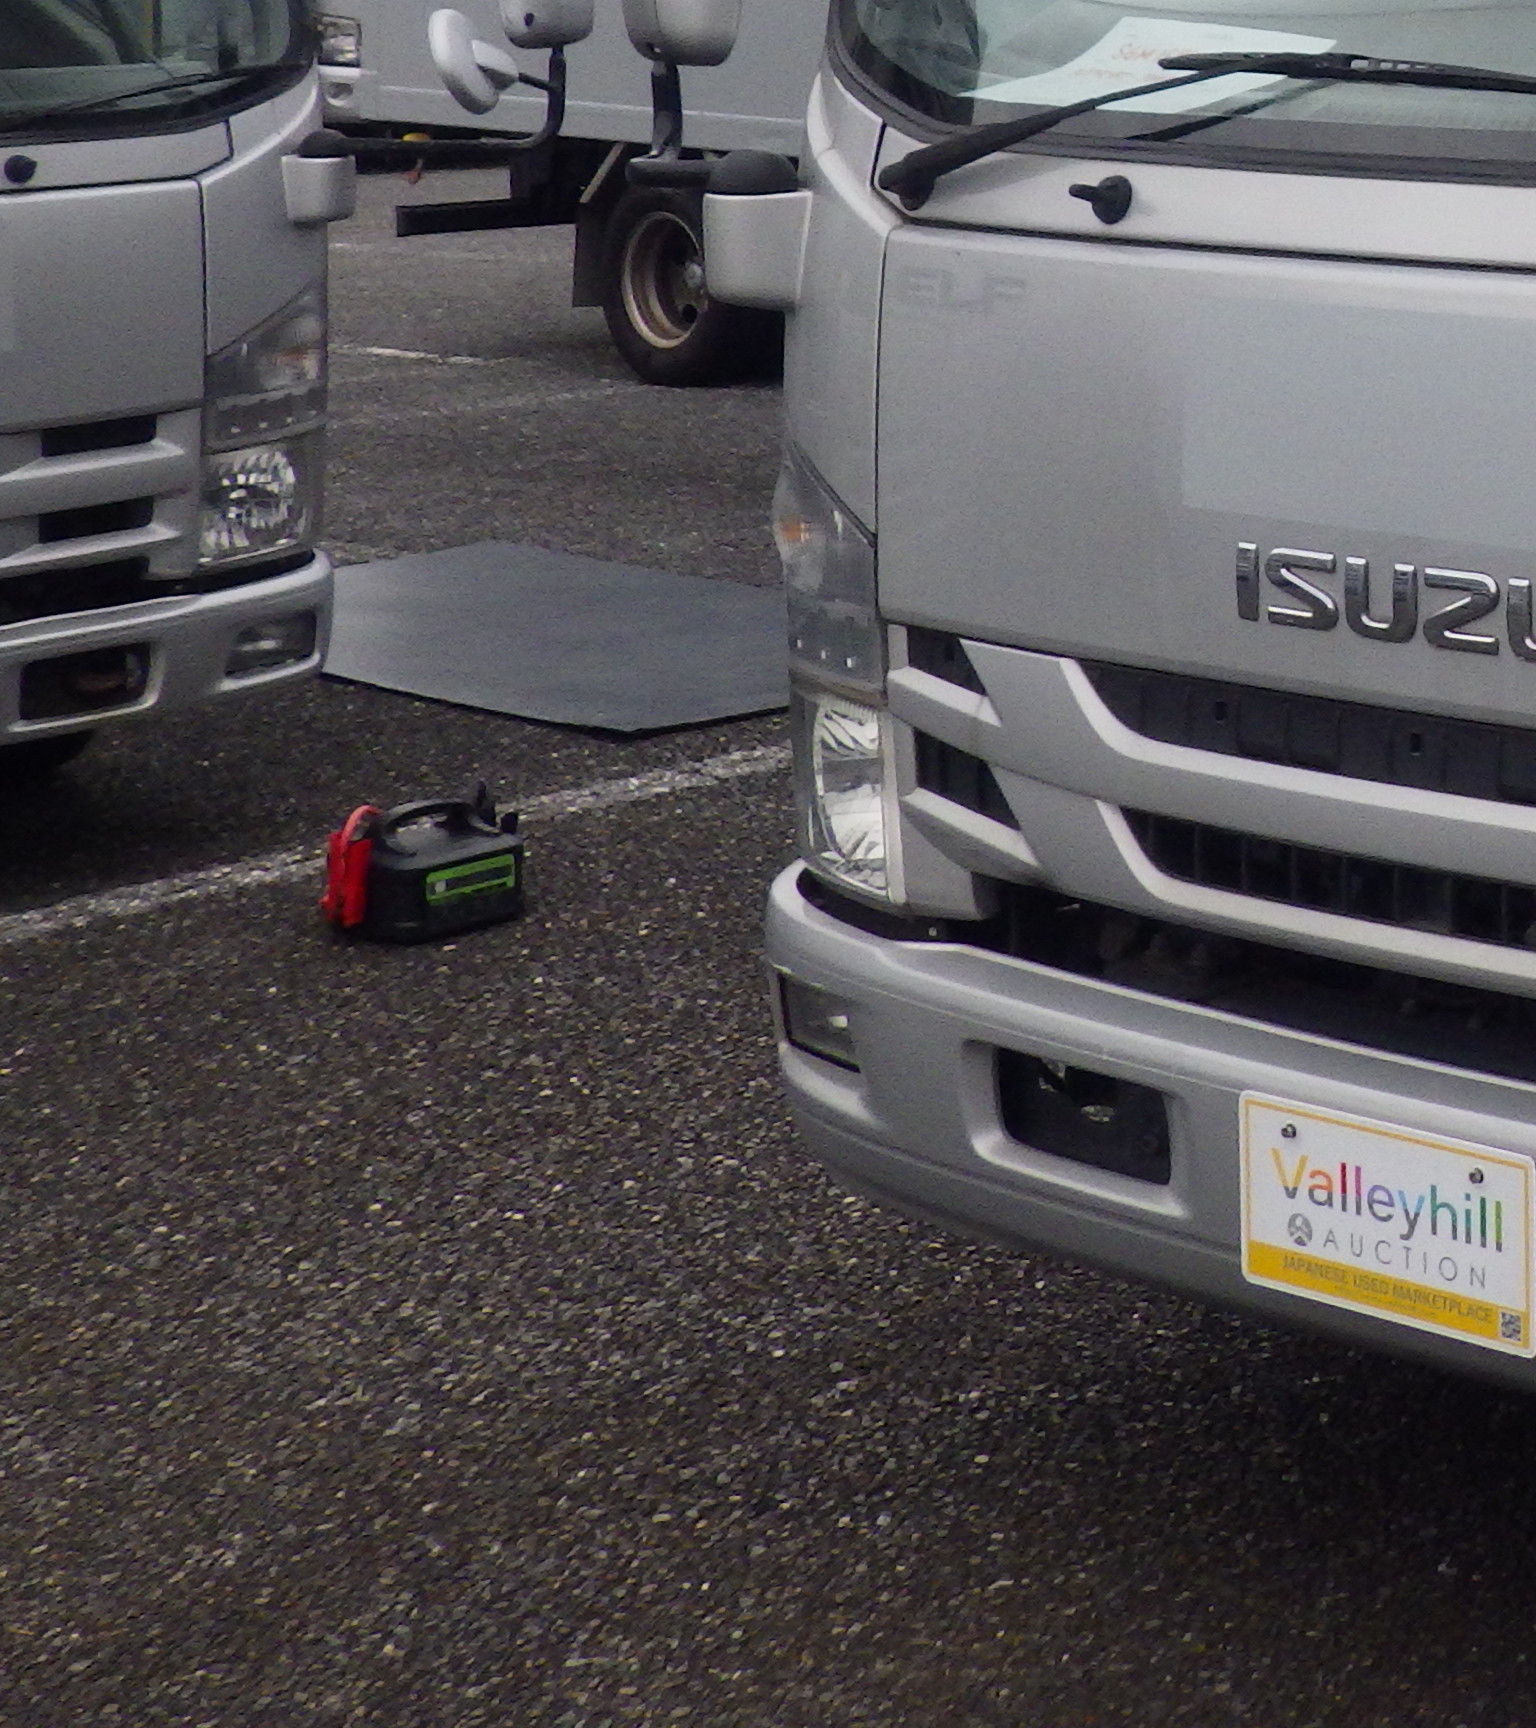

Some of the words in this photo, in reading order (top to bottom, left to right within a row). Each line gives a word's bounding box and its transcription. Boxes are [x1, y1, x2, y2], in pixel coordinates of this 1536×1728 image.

[1271, 1147, 1503, 1253] Valleyhill
[1283, 1255, 1348, 1286] JAPANESE
[1353, 1273, 1390, 1296] USED
[1392, 1283, 1495, 1323] MARKETPLACE
[1322, 1229, 1488, 1290] AUCTION
